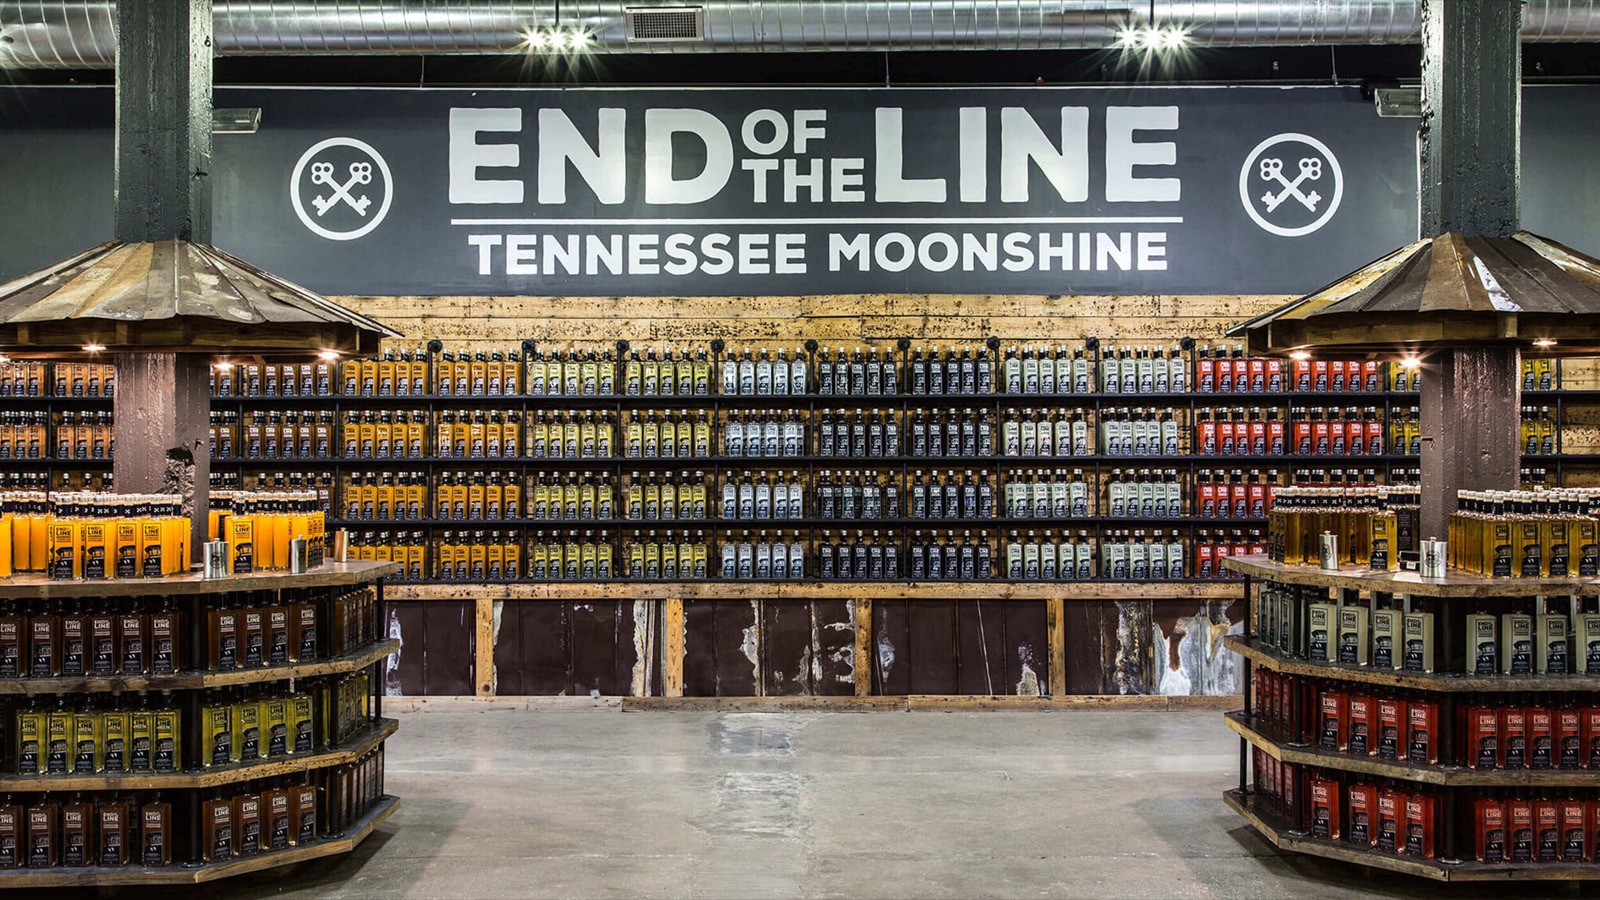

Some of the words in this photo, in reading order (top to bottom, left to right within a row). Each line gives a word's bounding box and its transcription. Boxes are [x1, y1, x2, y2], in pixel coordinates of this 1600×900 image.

[741, 108, 826, 155] OF
[875, 106, 1180, 202] LINE
[449, 107, 734, 204] END
[741, 158, 865, 202] THE
[468, 233, 807, 275] TENNESSEE
[829, 232, 1167, 272] MOONSHINE
